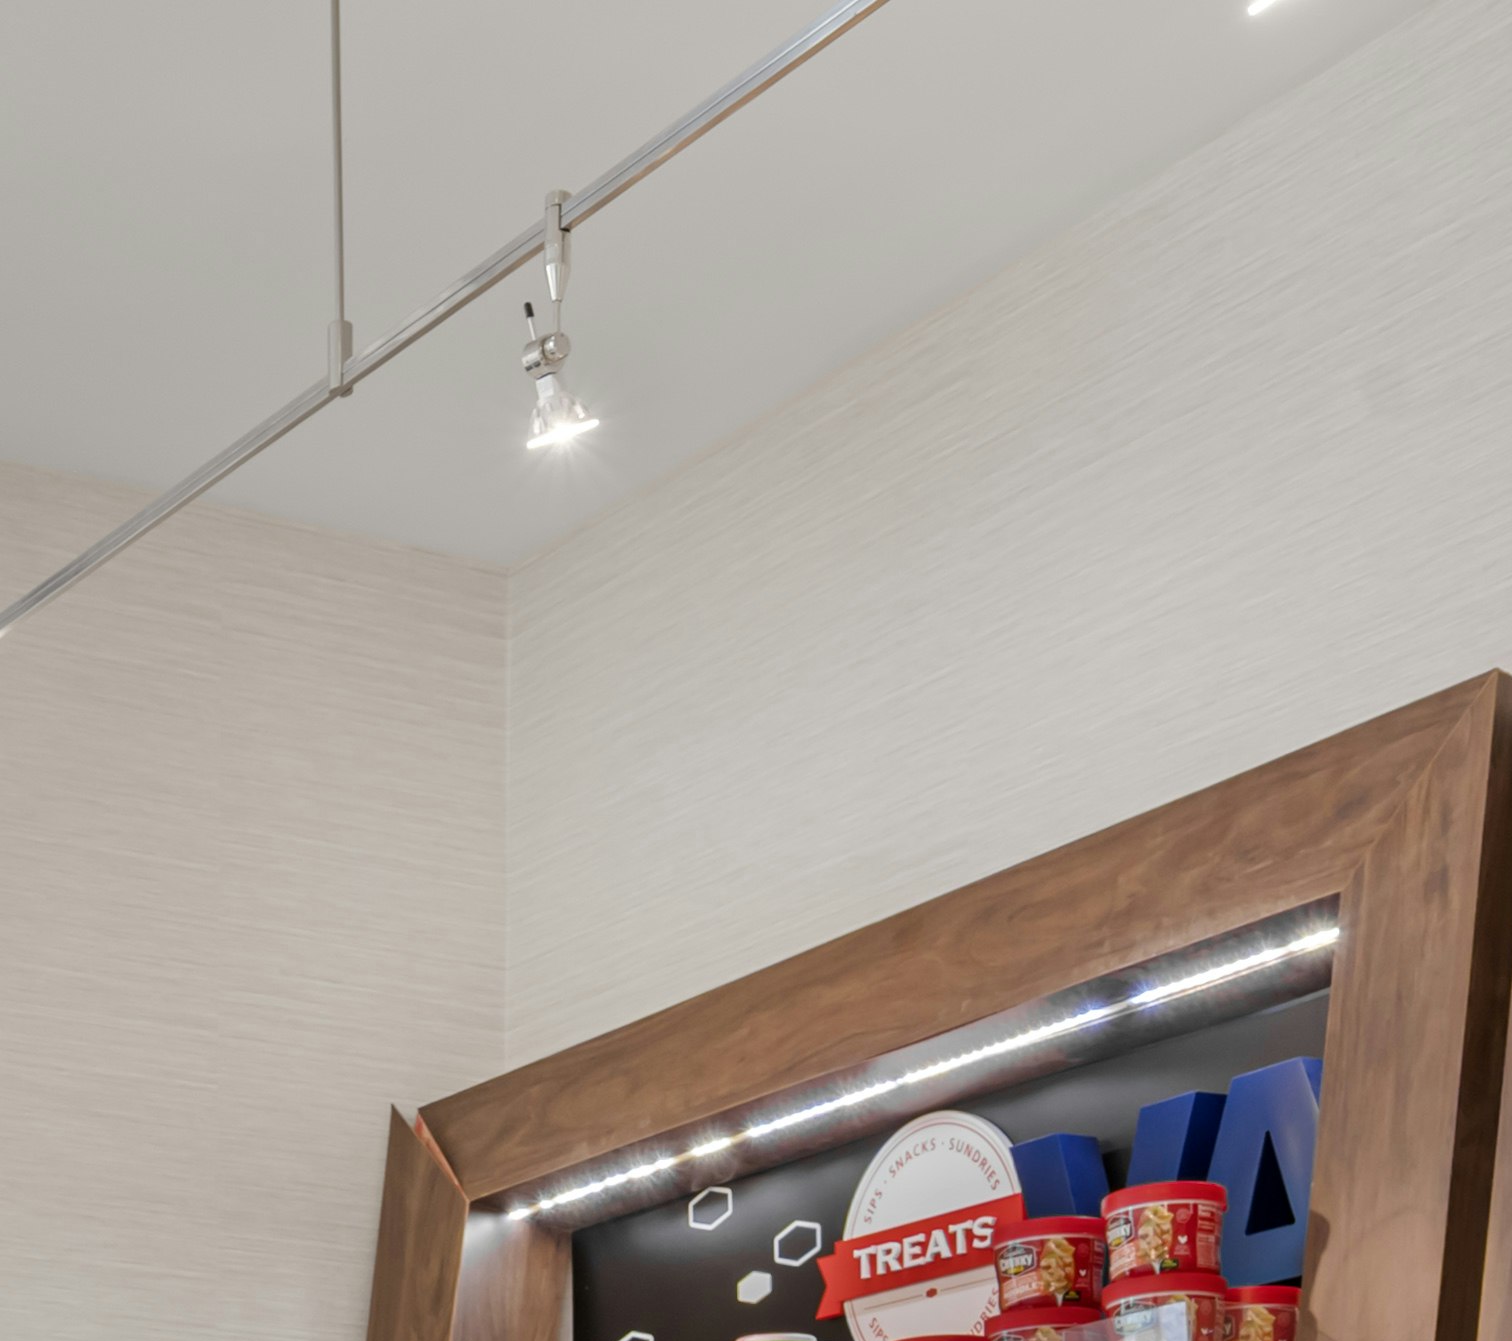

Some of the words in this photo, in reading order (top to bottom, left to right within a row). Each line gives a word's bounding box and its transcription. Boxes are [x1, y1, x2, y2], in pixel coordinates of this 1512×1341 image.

[863, 1188, 883, 1223] SIPS
[888, 1138, 937, 1178] SNACKS
[948, 1137, 1001, 1191] SUNDRIES
[853, 1215, 997, 1281] TREATS
